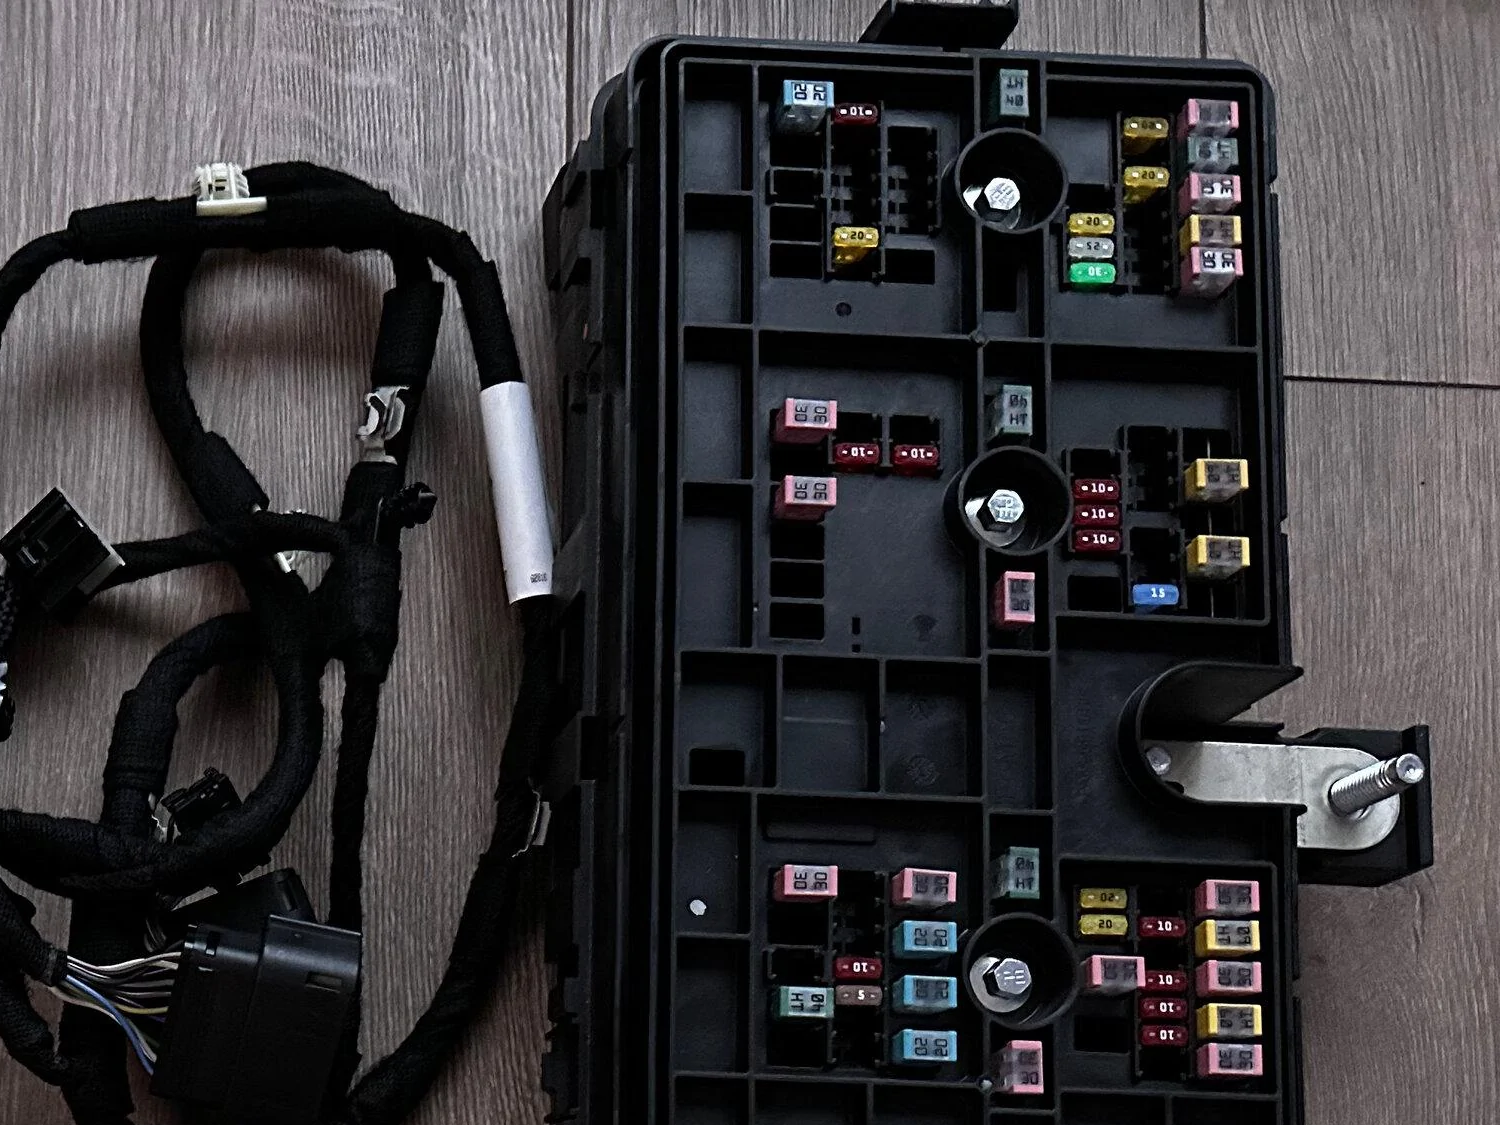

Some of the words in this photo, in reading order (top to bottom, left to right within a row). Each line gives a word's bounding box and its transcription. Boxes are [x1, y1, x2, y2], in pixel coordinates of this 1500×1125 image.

[795, 84, 807, 100] 20
[850, 106, 864, 116] 10
[1141, 171, 1155, 180] 20
[850, 231, 864, 241] 20
[1202, 250, 1216, 268] 30
[1222, 252, 1236, 269] 30
[794, 405, 808, 422] 30
[814, 406, 828, 423] 30
[1009, 413, 1028, 426] HT
[851, 446, 866, 457] 10
[911, 448, 925, 458] 10
[794, 482, 808, 500] 30
[814, 482, 827, 500] 30
[1091, 483, 1106, 493] 10
[1091, 508, 1106, 519] 10
[1092, 534, 1107, 544] 10
[1151, 588, 1166, 598] 15
[794, 872, 808, 890] 30
[814, 872, 828, 890] 30
[1100, 893, 1115, 902] 20
[1098, 920, 1112, 929] 20
[1158, 922, 1172, 931] 10
[914, 928, 928, 946] 20
[934, 928, 948, 947] 20
[1218, 926, 1231, 944] HT
[853, 962, 868, 972] 10
[1158, 975, 1172, 984] 10
[790, 992, 804, 1011] HT
[811, 993, 824, 1012] 40
[1160, 1002, 1174, 1012] 10
[1160, 1030, 1174, 1040] 10
[914, 1038, 928, 1056] 20
[934, 1038, 948, 1057] 20
